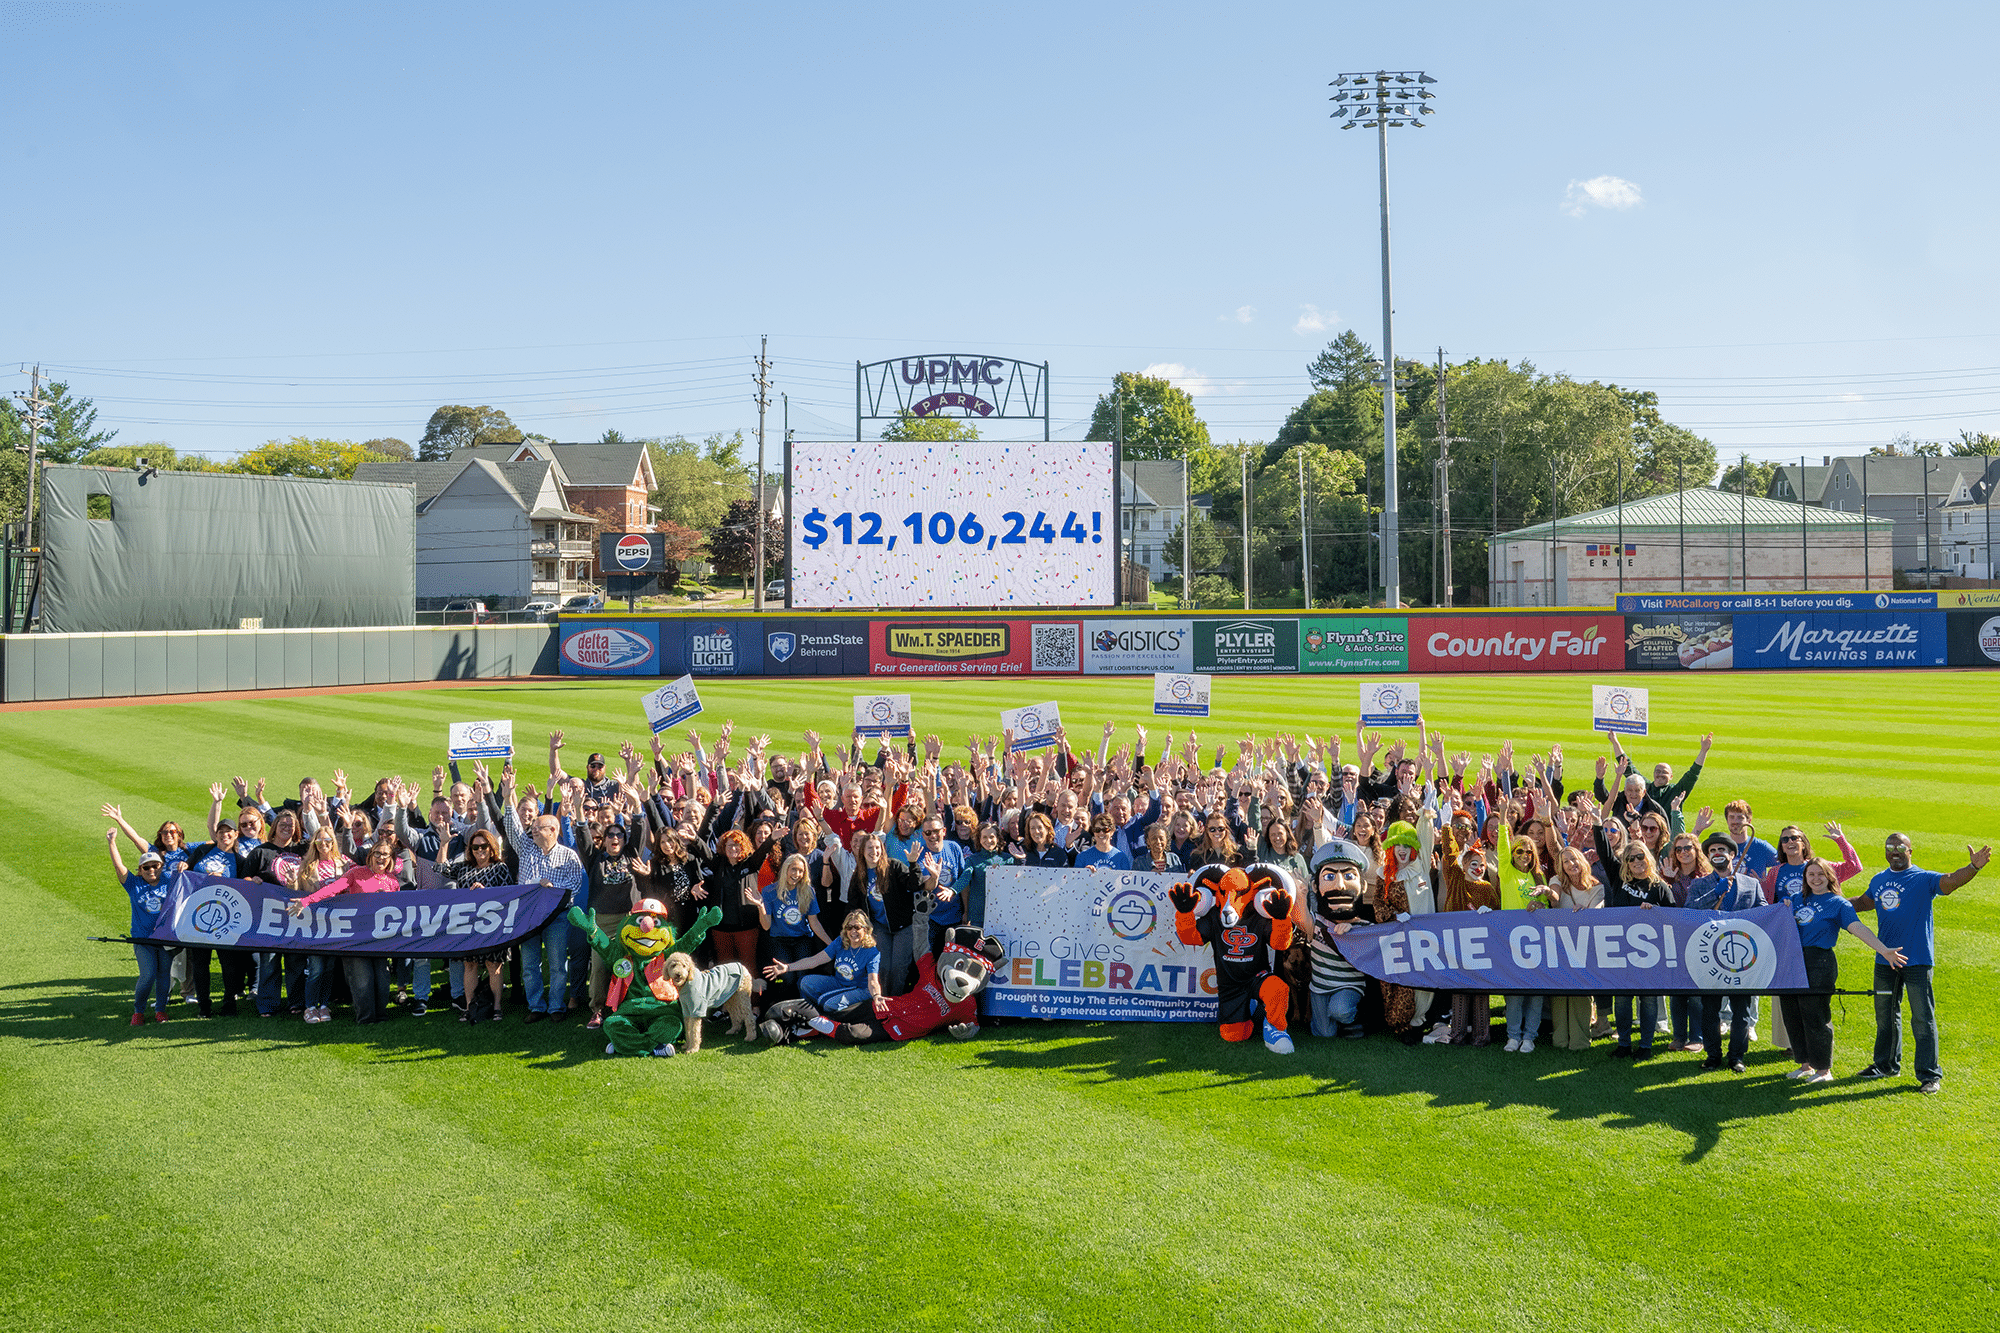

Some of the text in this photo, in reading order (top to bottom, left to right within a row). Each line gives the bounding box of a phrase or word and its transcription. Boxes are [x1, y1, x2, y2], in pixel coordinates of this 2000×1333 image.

[901, 359, 1004, 385] UPMC
[922, 395, 985, 412] PARK
[802, 507, 1102, 551] $12,106,244!
[618, 548, 649, 556] PEPSI
[1589, 559, 1634, 567] ERIE
[1640, 597, 1854, 610] Visit PA1Call.org or call 8-1-1 before you dig.
[1375, 630, 1404, 643] Tire
[1632, 622, 1683, 638] Smith's
[577, 633, 609, 650] delta
[693, 635, 733, 652] Blue
[800, 634, 864, 646] PennState
[937, 632, 1001, 647] SPAEDER
[1215, 633, 1276, 648] PLYLER
[1427, 630, 1607, 661] Country Fair
[1755, 620, 1919, 661] Marquette
[800, 647, 837, 657] Behrend
[1344, 643, 1405, 652] & Auto Service
[577, 650, 610, 664] sonic
[693, 652, 734, 666] LIGHT
[1217, 657, 1275, 665] PlylerEntry.com
[1308, 658, 1400, 668] www.FlynnsTire.com
[1805, 650, 1917, 661] SAVINGS BANK
[874, 662, 1023, 674] Four Generations Serving Erie!
[214, 888, 240, 908] ERIE
[1091, 875, 1167, 917] ERIE GIVES
[214, 911, 242, 940] GIVES
[256, 897, 520, 940] ERIE GIVES!
[1049, 935, 1126, 962] Gives
[1378, 923, 1678, 975] ERIE GIVES!
[1699, 923, 1742, 985] GIVES ERIE
[995, 992, 1037, 1003] Brought
[1039, 993, 1051, 1003] to
[1052, 995, 1072, 1004] you
[1073, 995, 1086, 1006] by
[1087, 995, 1106, 1005] The
[1108, 996, 1129, 1005] Erie
[1131, 997, 1192, 1009] Community
[1031, 1004, 1218, 1019] & our generous community partners!
